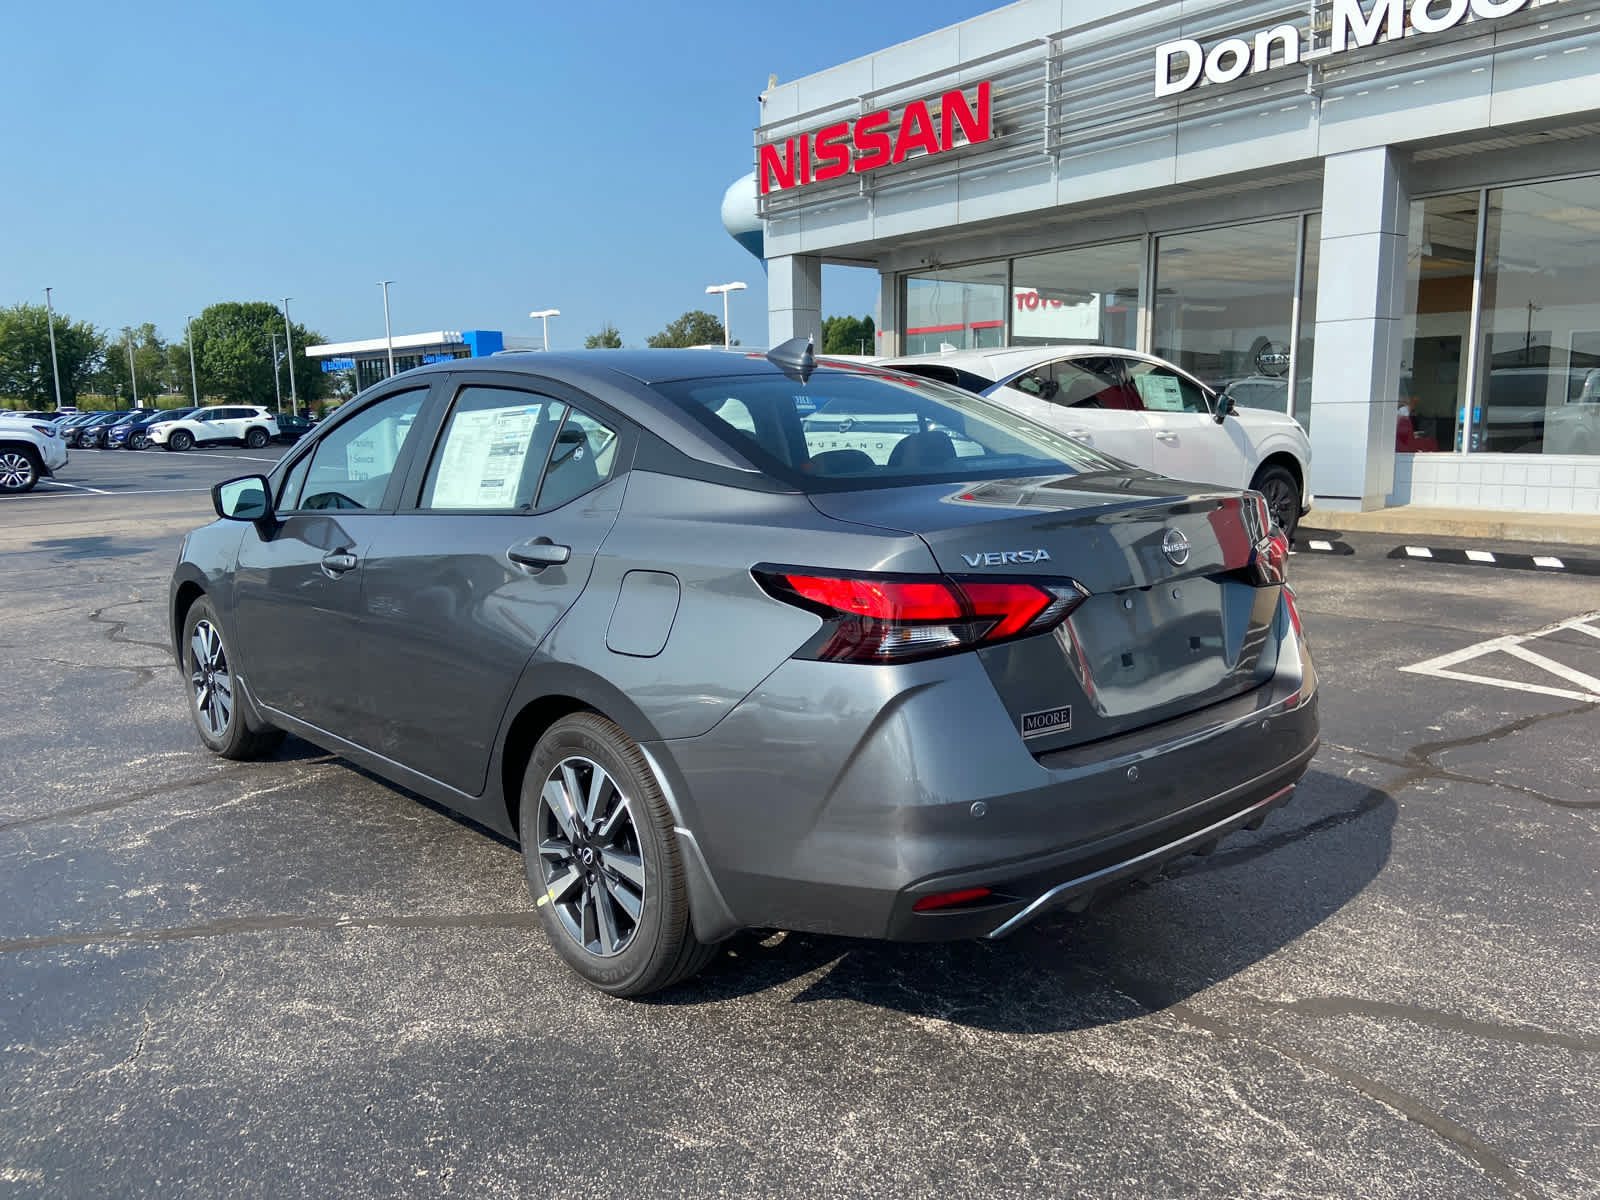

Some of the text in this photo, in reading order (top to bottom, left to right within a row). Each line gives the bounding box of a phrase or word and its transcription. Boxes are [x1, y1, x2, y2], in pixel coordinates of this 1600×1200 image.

[1155, 23, 1302, 98] Don
[760, 81, 991, 195] NISSAN
[960, 548, 1051, 568] VERSA
[1026, 710, 1068, 729] MOORE
